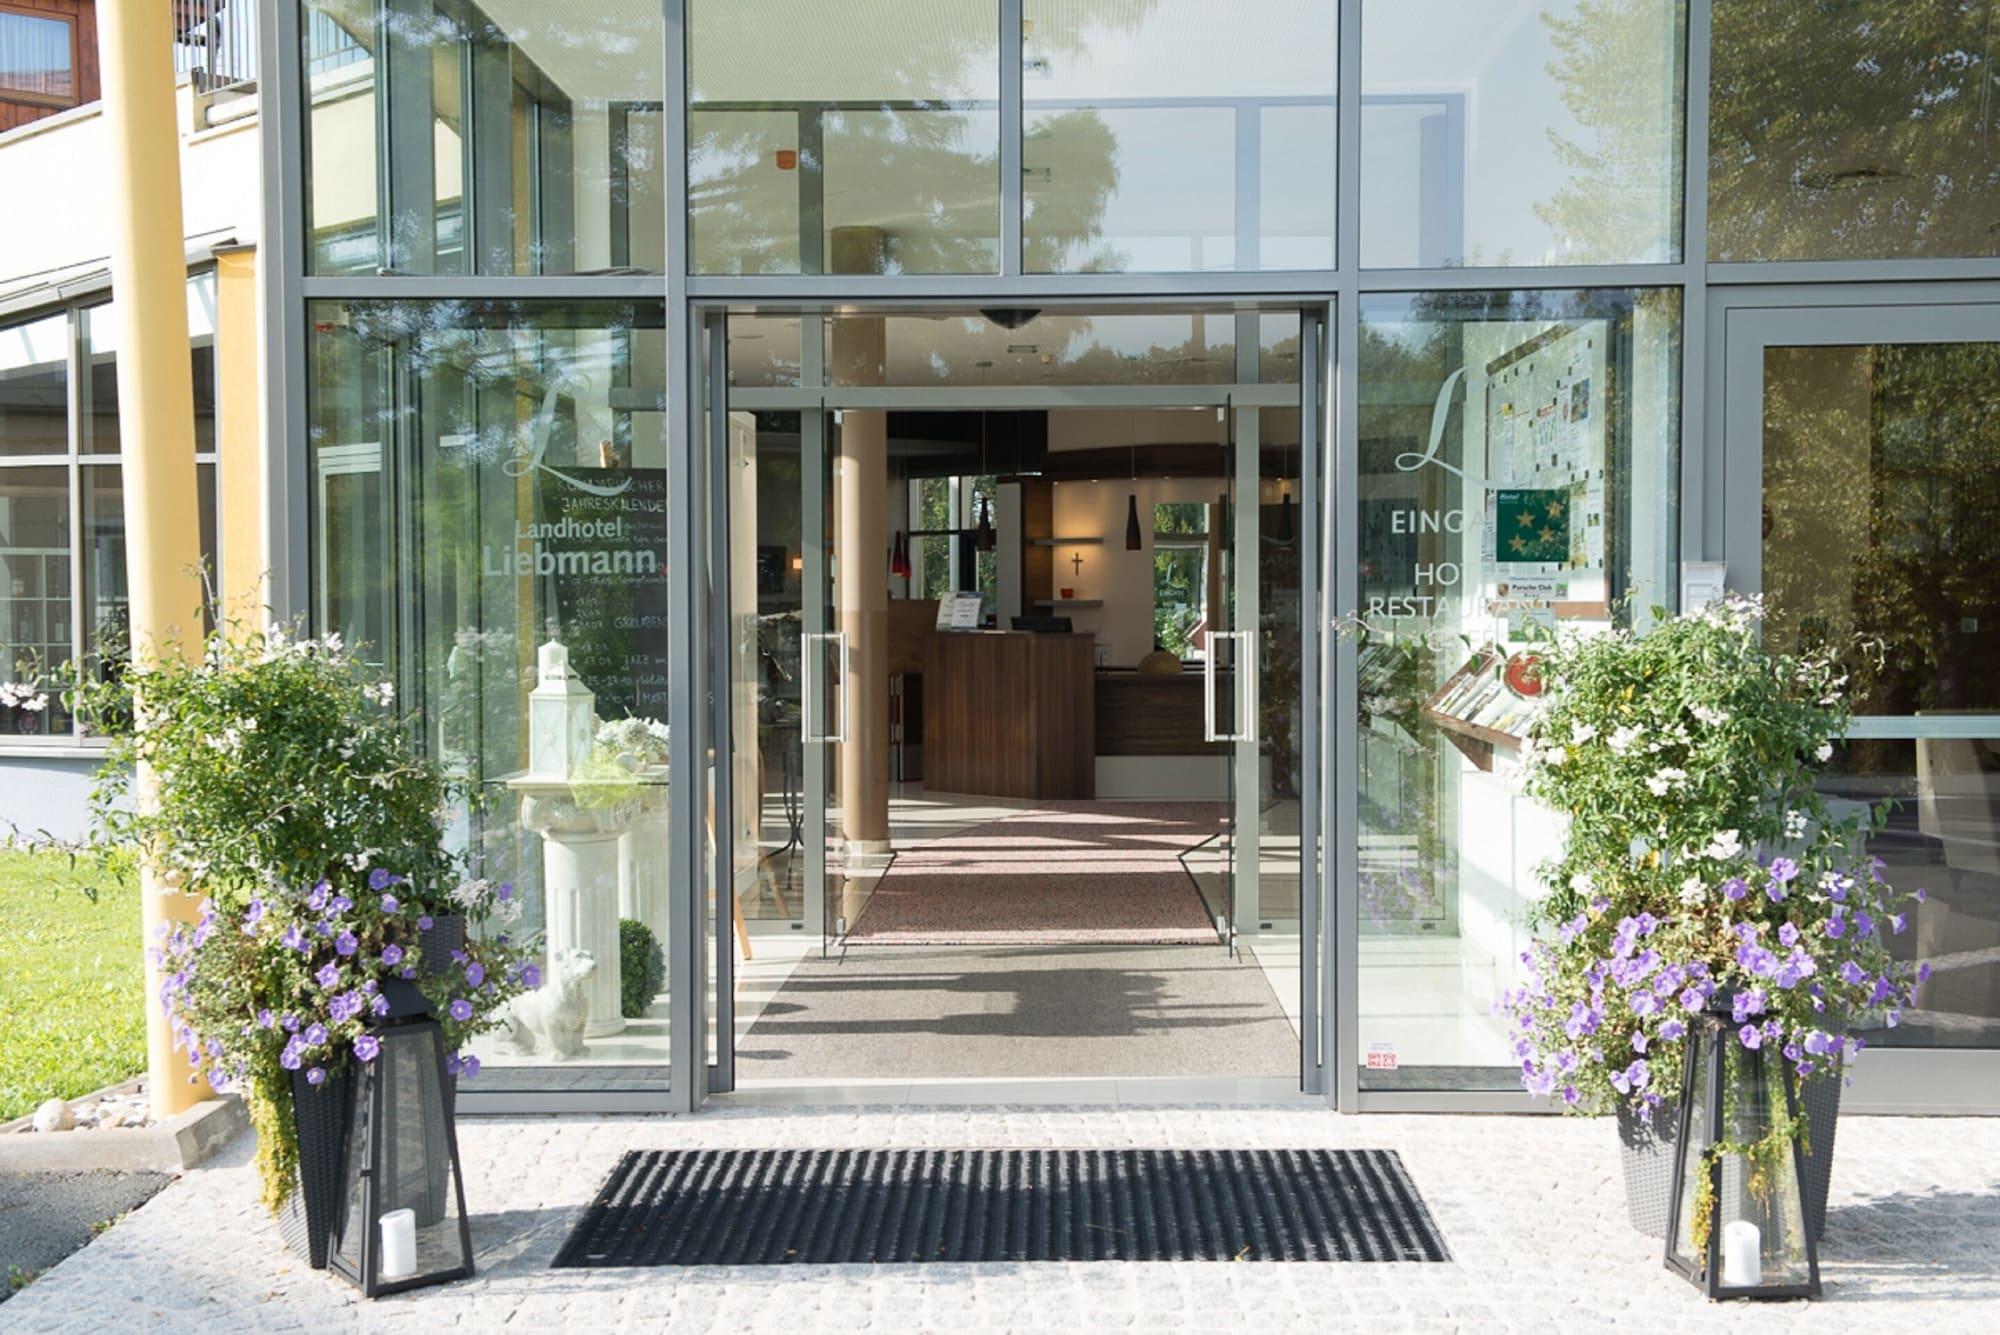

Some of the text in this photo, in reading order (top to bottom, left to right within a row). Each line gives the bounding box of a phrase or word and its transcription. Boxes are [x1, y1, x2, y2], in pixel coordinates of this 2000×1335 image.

[561, 497, 666, 513] JAHRESKALENDE
[515, 516, 622, 539] Landhotel
[482, 543, 657, 577] Liebmann
